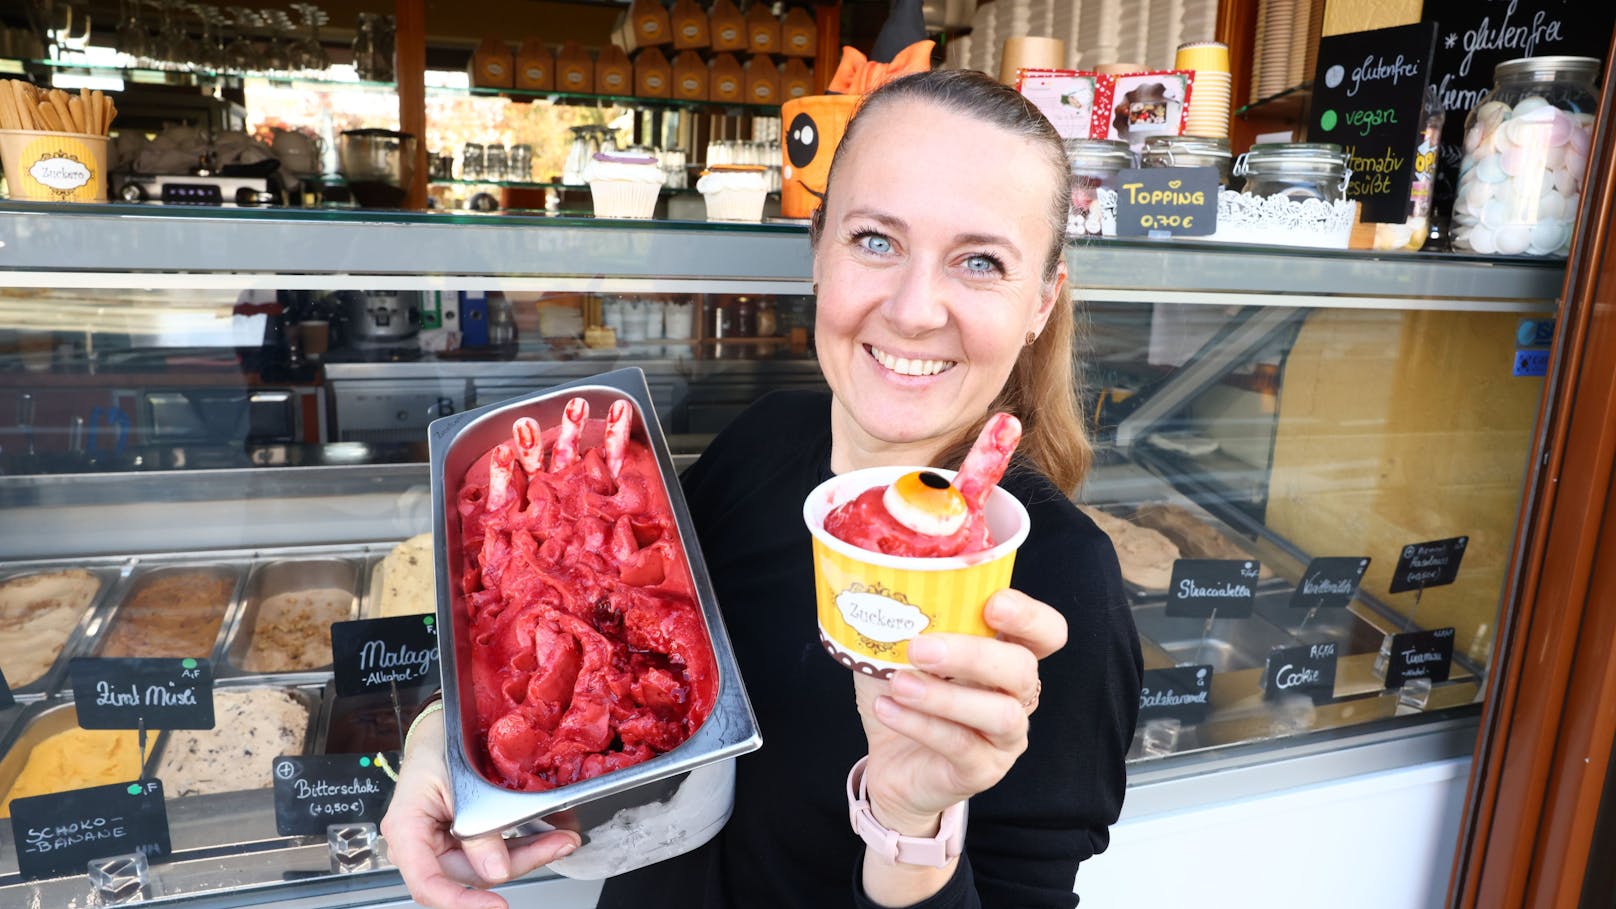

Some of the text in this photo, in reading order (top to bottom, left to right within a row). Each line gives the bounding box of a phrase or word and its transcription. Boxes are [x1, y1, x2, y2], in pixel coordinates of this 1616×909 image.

[1347, 54, 1420, 97] glutenfrei
[1345, 108, 1398, 136] vegan
[1345, 145, 1404, 174] lternativ
[41, 166, 85, 180] Zuckero
[1346, 173, 1392, 196] esüßt
[1122, 179, 1205, 206] TOPPING
[848, 602, 915, 629] Zuckero
[1276, 664, 1320, 689] Cookie
[96, 680, 198, 706] Zimt Müsli
[294, 777, 380, 799] Bitterschoki
